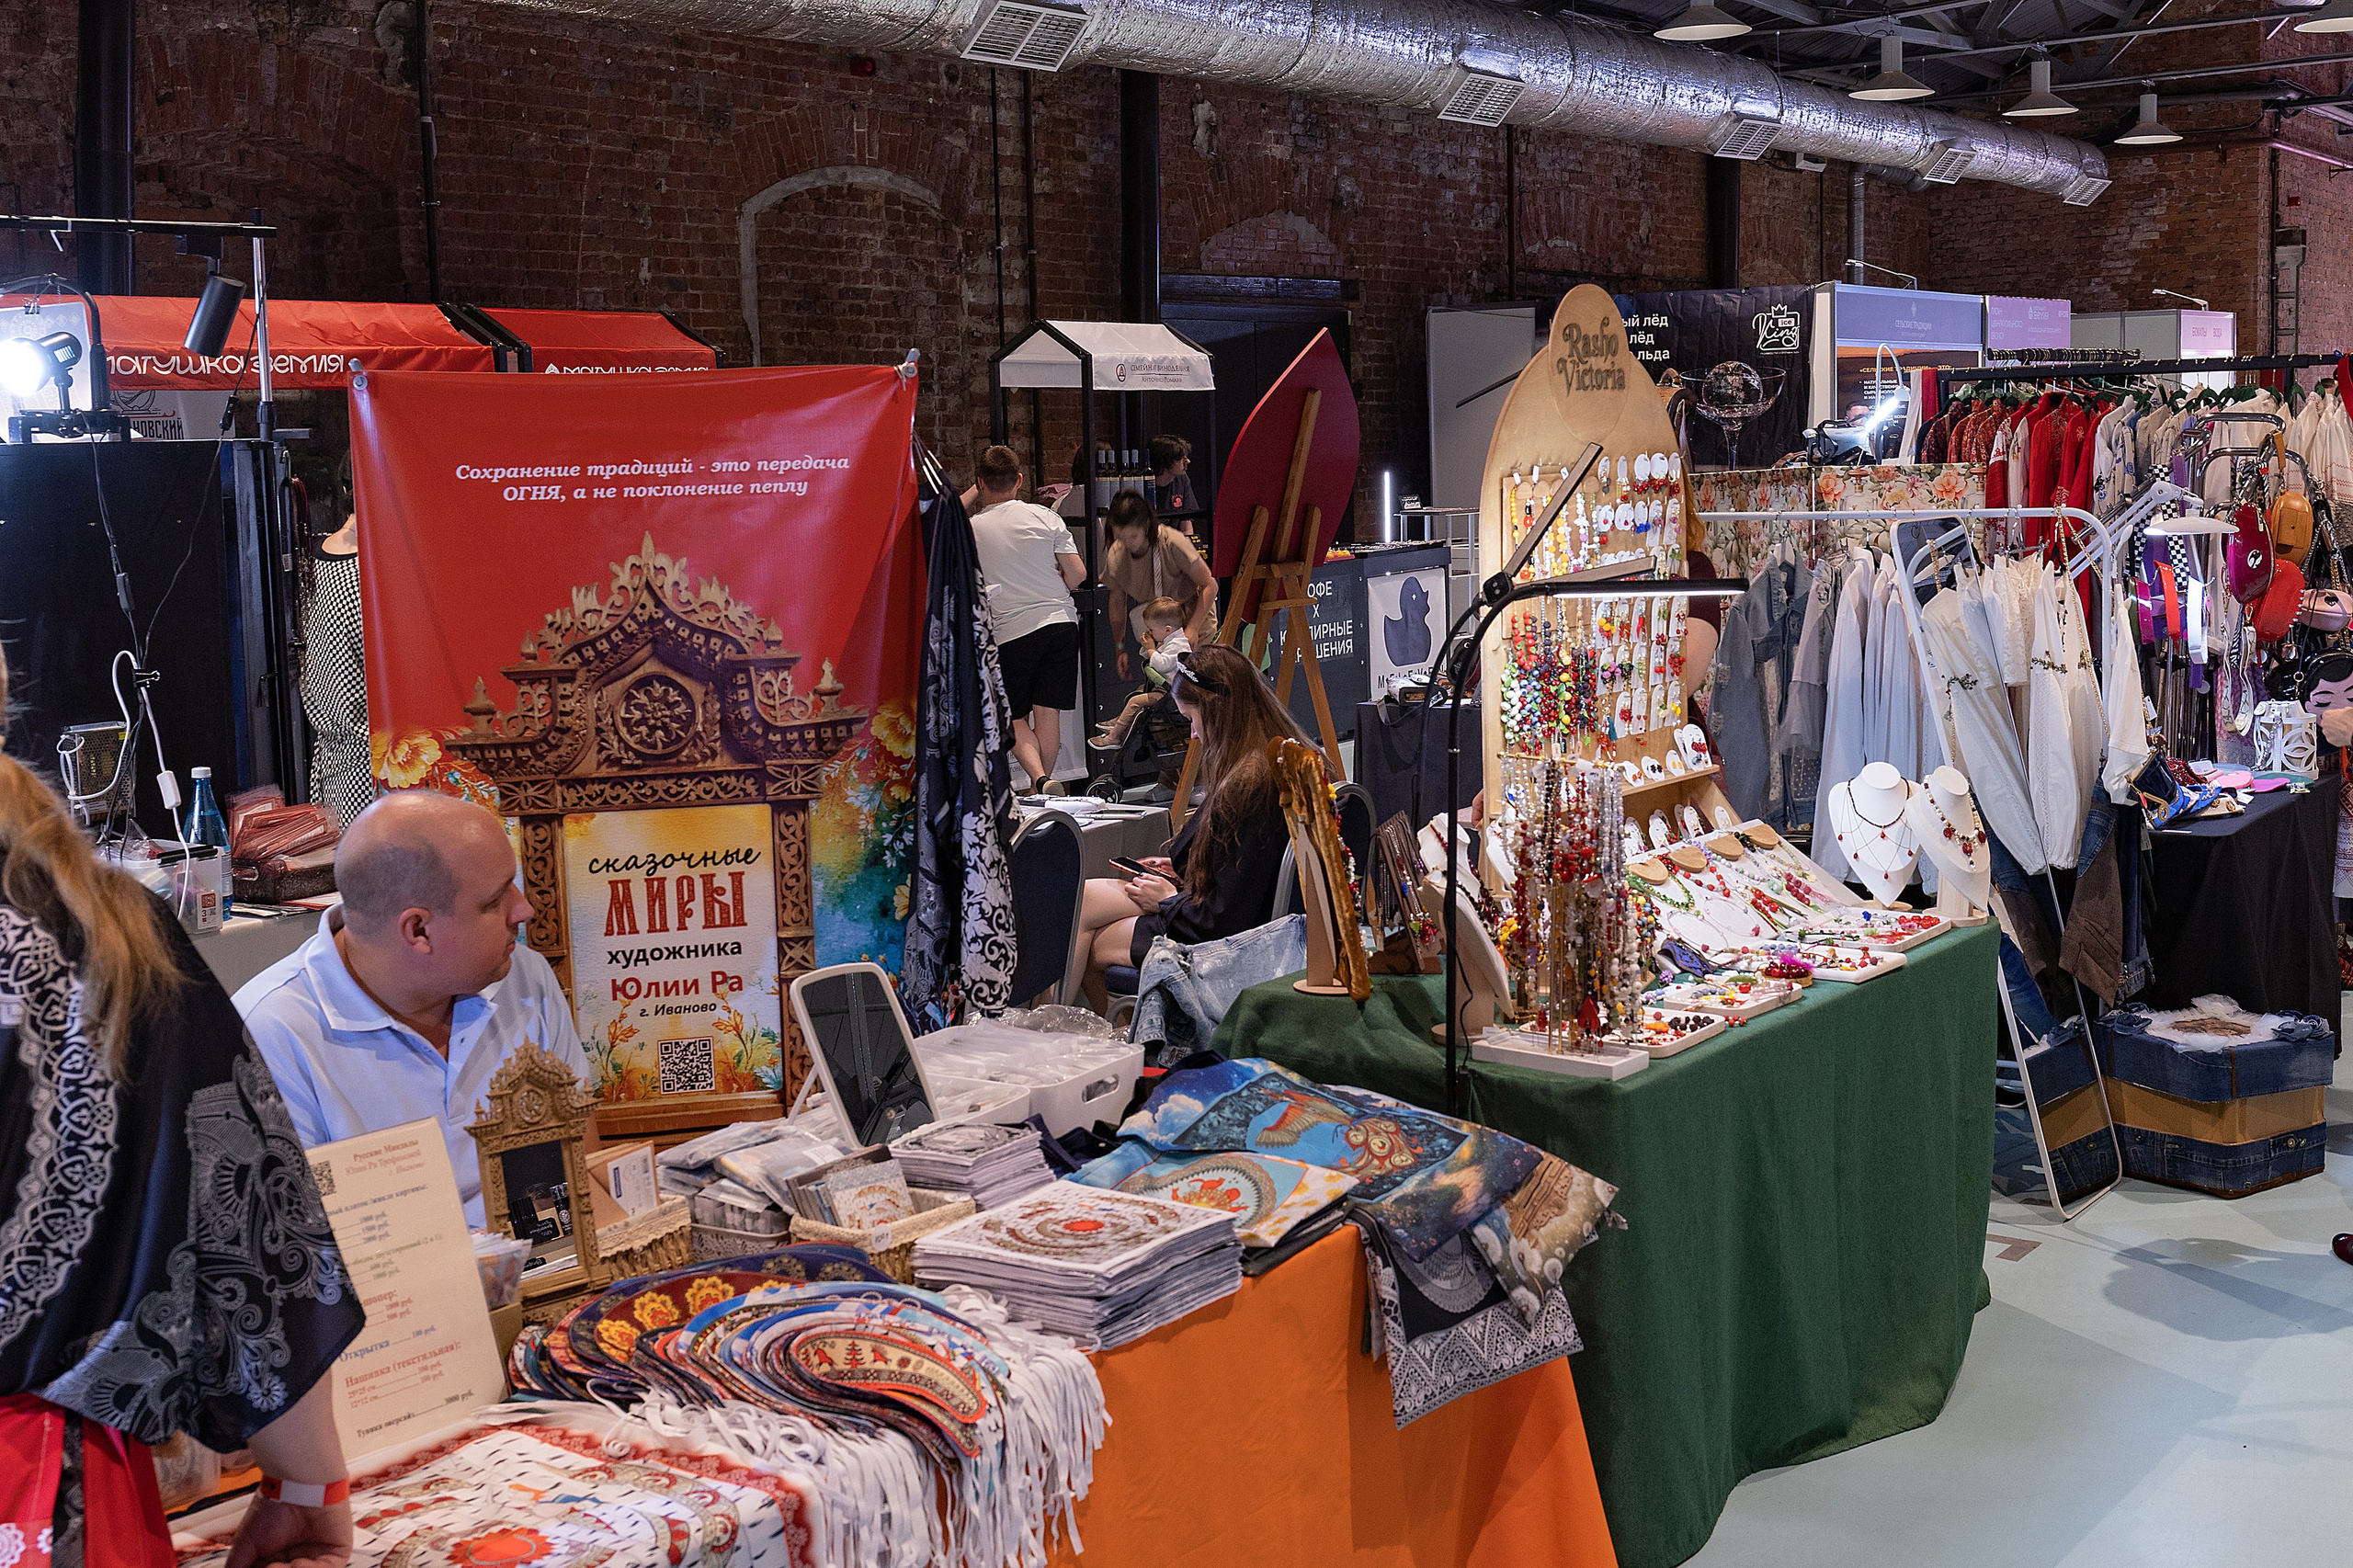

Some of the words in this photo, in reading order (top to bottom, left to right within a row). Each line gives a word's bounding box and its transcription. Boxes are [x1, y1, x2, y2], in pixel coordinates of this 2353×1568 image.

[1643, 313, 1669, 327] лёд
[1563, 316, 1620, 365] Rasho
[1629, 331, 1655, 346] лёд
[1637, 349, 1670, 361] льда
[1557, 358, 1626, 397] Victoria
[456, 464, 581, 483] Сохранение
[586, 458, 694, 480] традиций
[710, 460, 751, 472] это
[756, 454, 850, 475] передача
[503, 485, 566, 503] ОГНЯ,
[574, 488, 587, 499] а
[593, 487, 617, 498] не
[623, 483, 744, 498] поклонение
[749, 481, 809, 496] пеплу
[1307, 580, 1333, 597] ОФЕ
[588, 847, 761, 876] сказочные
[603, 870, 748, 937] МИРЫ
[607, 940, 743, 969] художника
[611, 977, 699, 1002] Юлии
[710, 970, 744, 994] Ра
[640, 1007, 650, 1017] г.
[654, 1003, 717, 1017] Иваново
[361, 1290, 398, 1307] шопер:
[338, 1340, 390, 1362] Открытка
[345, 1365, 391, 1388] Нашивка
